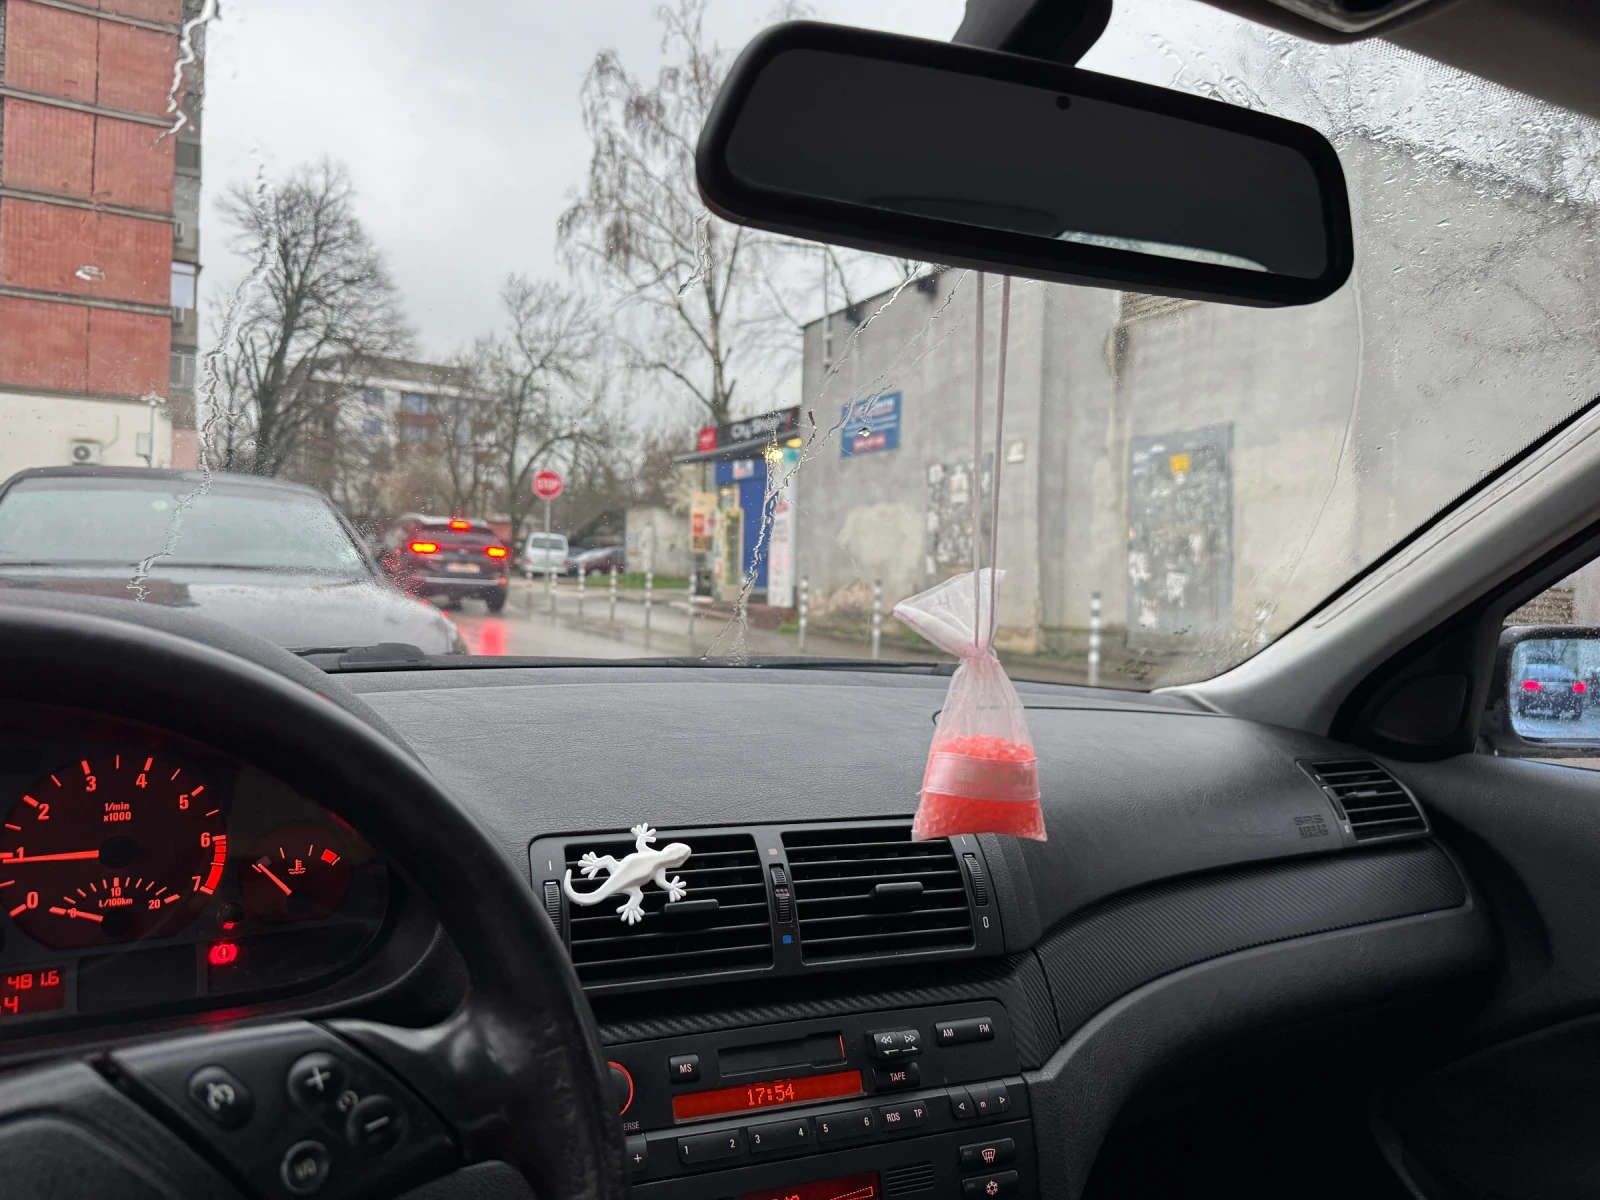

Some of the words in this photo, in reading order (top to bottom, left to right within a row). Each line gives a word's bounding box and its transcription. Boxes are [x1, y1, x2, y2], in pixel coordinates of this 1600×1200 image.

[537, 478, 560, 490] STOP
[86, 776, 97, 791] 3
[136, 773, 147, 788] 4
[104, 802, 130, 812] 1/min
[179, 794, 189, 810] 5
[38, 803, 49, 820] 2
[103, 812, 131, 822] x1000
[200, 832, 210, 847] 6
[17, 846, 24, 863] 1
[192, 876, 201, 891] 7
[111, 887, 121, 897] 10
[26, 891, 39, 908] 0
[148, 899, 160, 909] 20
[0, 996, 19, 1014] 4
[943, 1029, 954, 1038] AM
[979, 1024, 990, 1033] FM
[679, 1063, 692, 1074] MS
[890, 1071, 906, 1082] TAPE
[747, 1083, 795, 1106] 17:54
[864, 1117, 870, 1126] 6
[886, 1112, 900, 1123] RDS
[914, 1109, 923, 1119] TP
[621, 1121, 640, 1132] ERSE
[798, 1127, 804, 1137] 4
[823, 1123, 829, 1133] 5
[729, 1139, 736, 1148] 2
[755, 1134, 761, 1144] 3
[684, 1146, 689, 1155] 1
